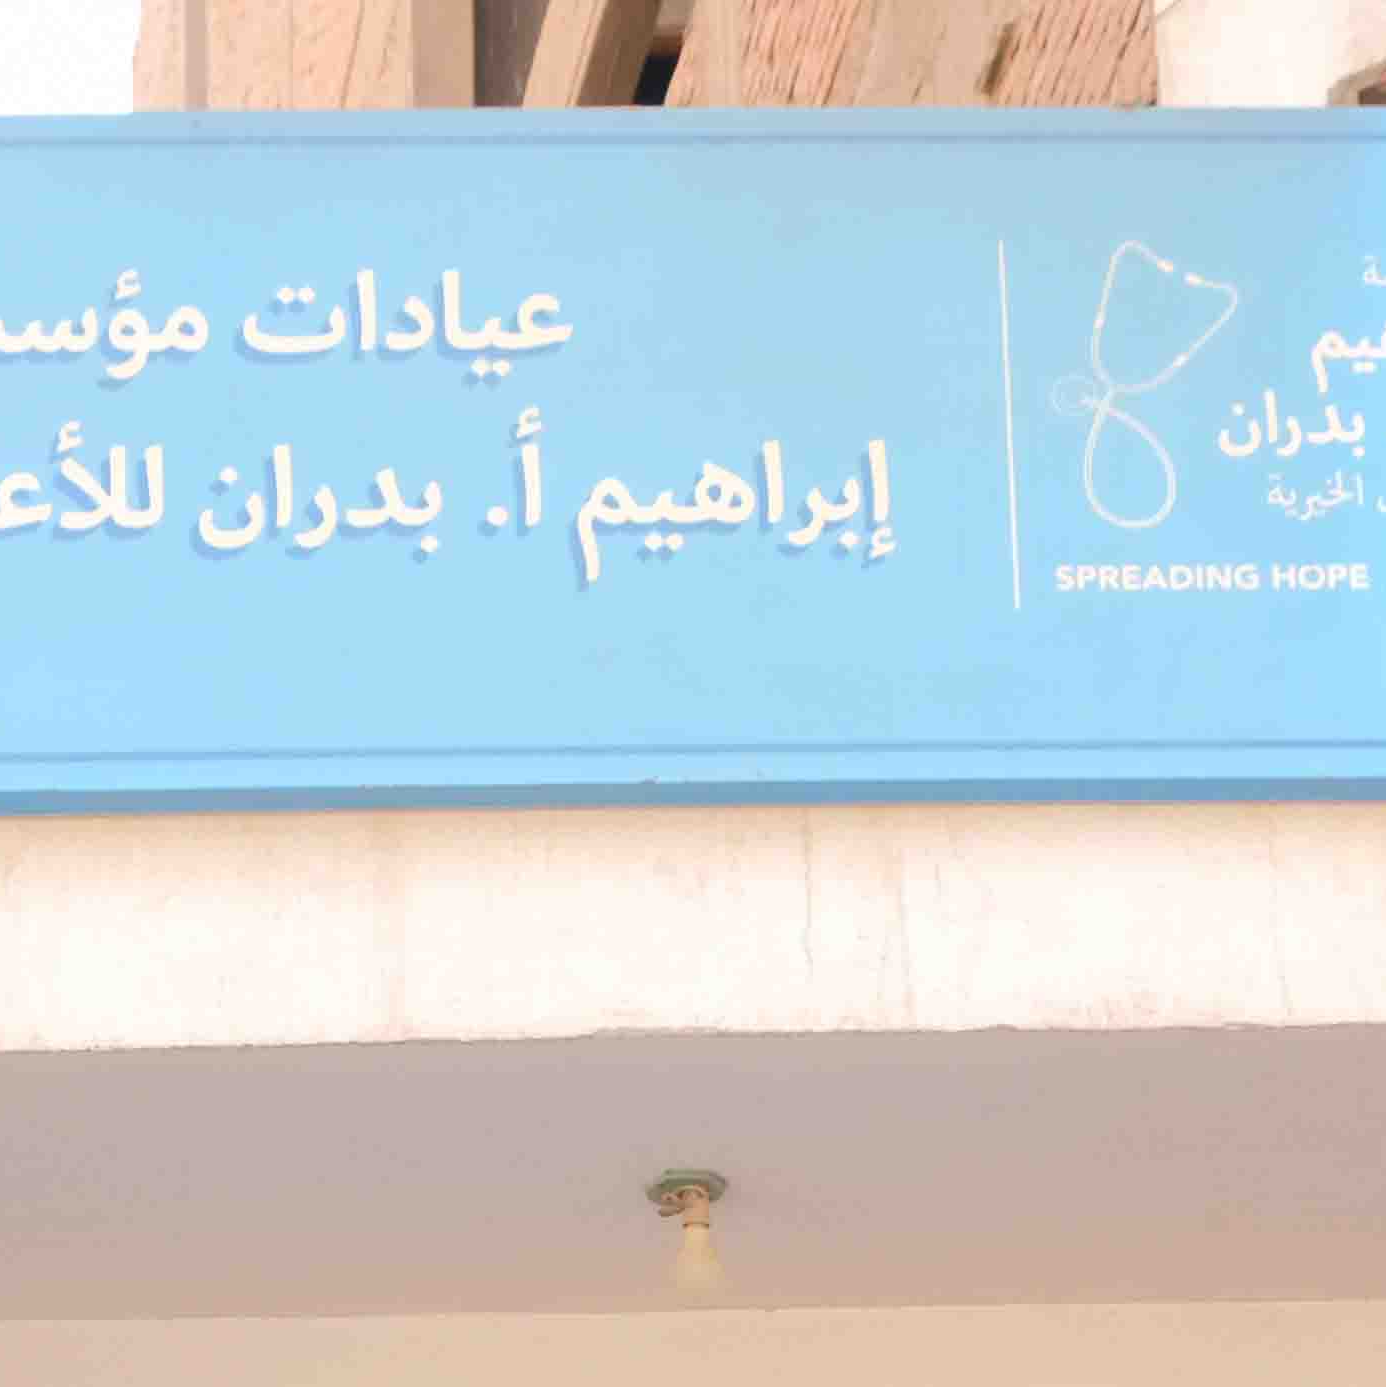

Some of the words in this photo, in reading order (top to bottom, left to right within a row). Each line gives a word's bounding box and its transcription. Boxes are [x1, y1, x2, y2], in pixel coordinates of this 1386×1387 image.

[242, 268, 574, 377] عيادات
[1217, 388, 1366, 459] بدران
[198, 443, 444, 554] بدران
[575, 438, 897, 583] إبراهيم
[1267, 469, 1365, 520] الخيرية
[1054, 563, 1260, 592] SPREADING
[1271, 563, 1372, 592] HOPE
